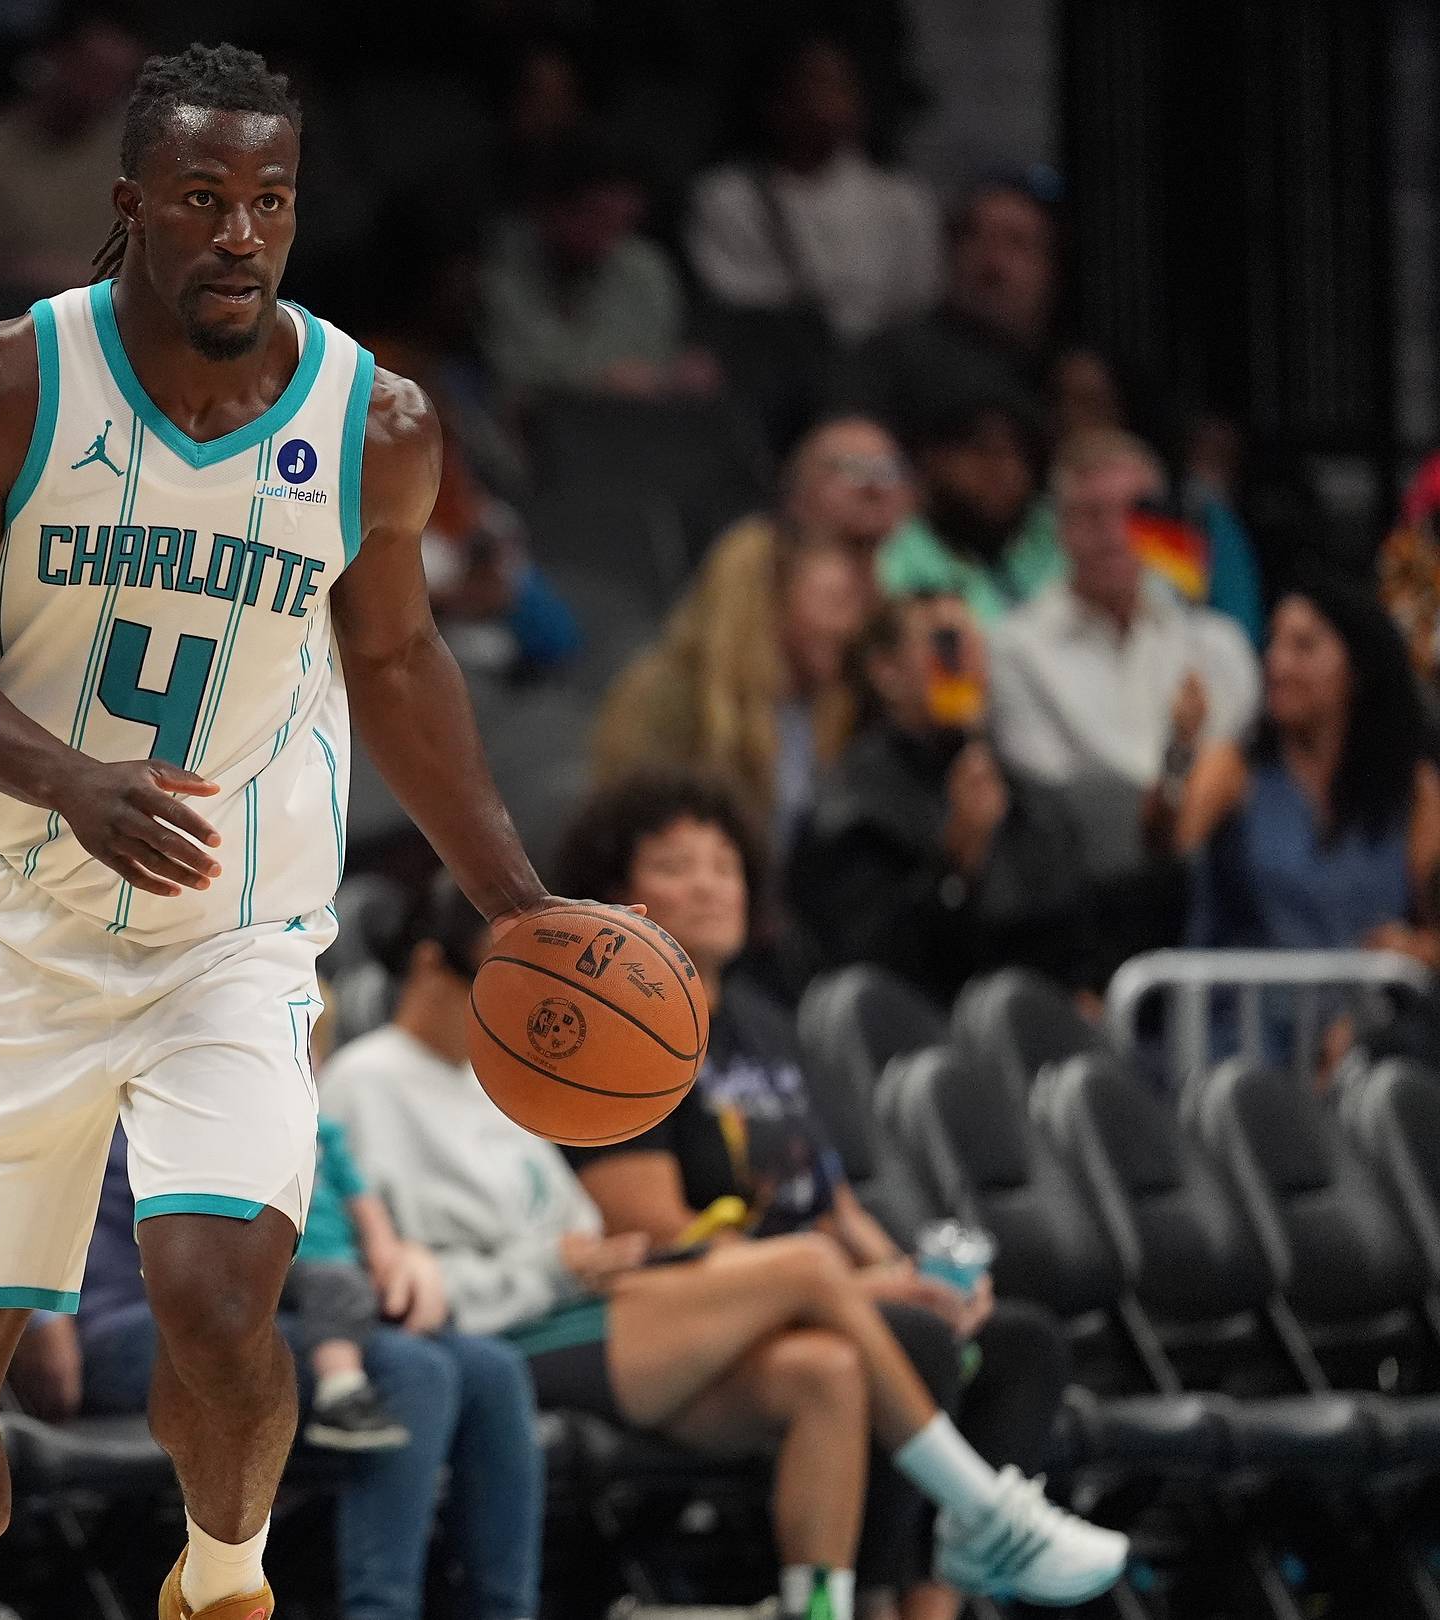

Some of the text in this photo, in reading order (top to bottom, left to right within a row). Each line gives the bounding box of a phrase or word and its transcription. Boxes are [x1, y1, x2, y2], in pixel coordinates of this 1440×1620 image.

[288, 486, 328, 505] Health
[37, 524, 326, 618] CHARLOTTE
[96, 617, 219, 771] 4
